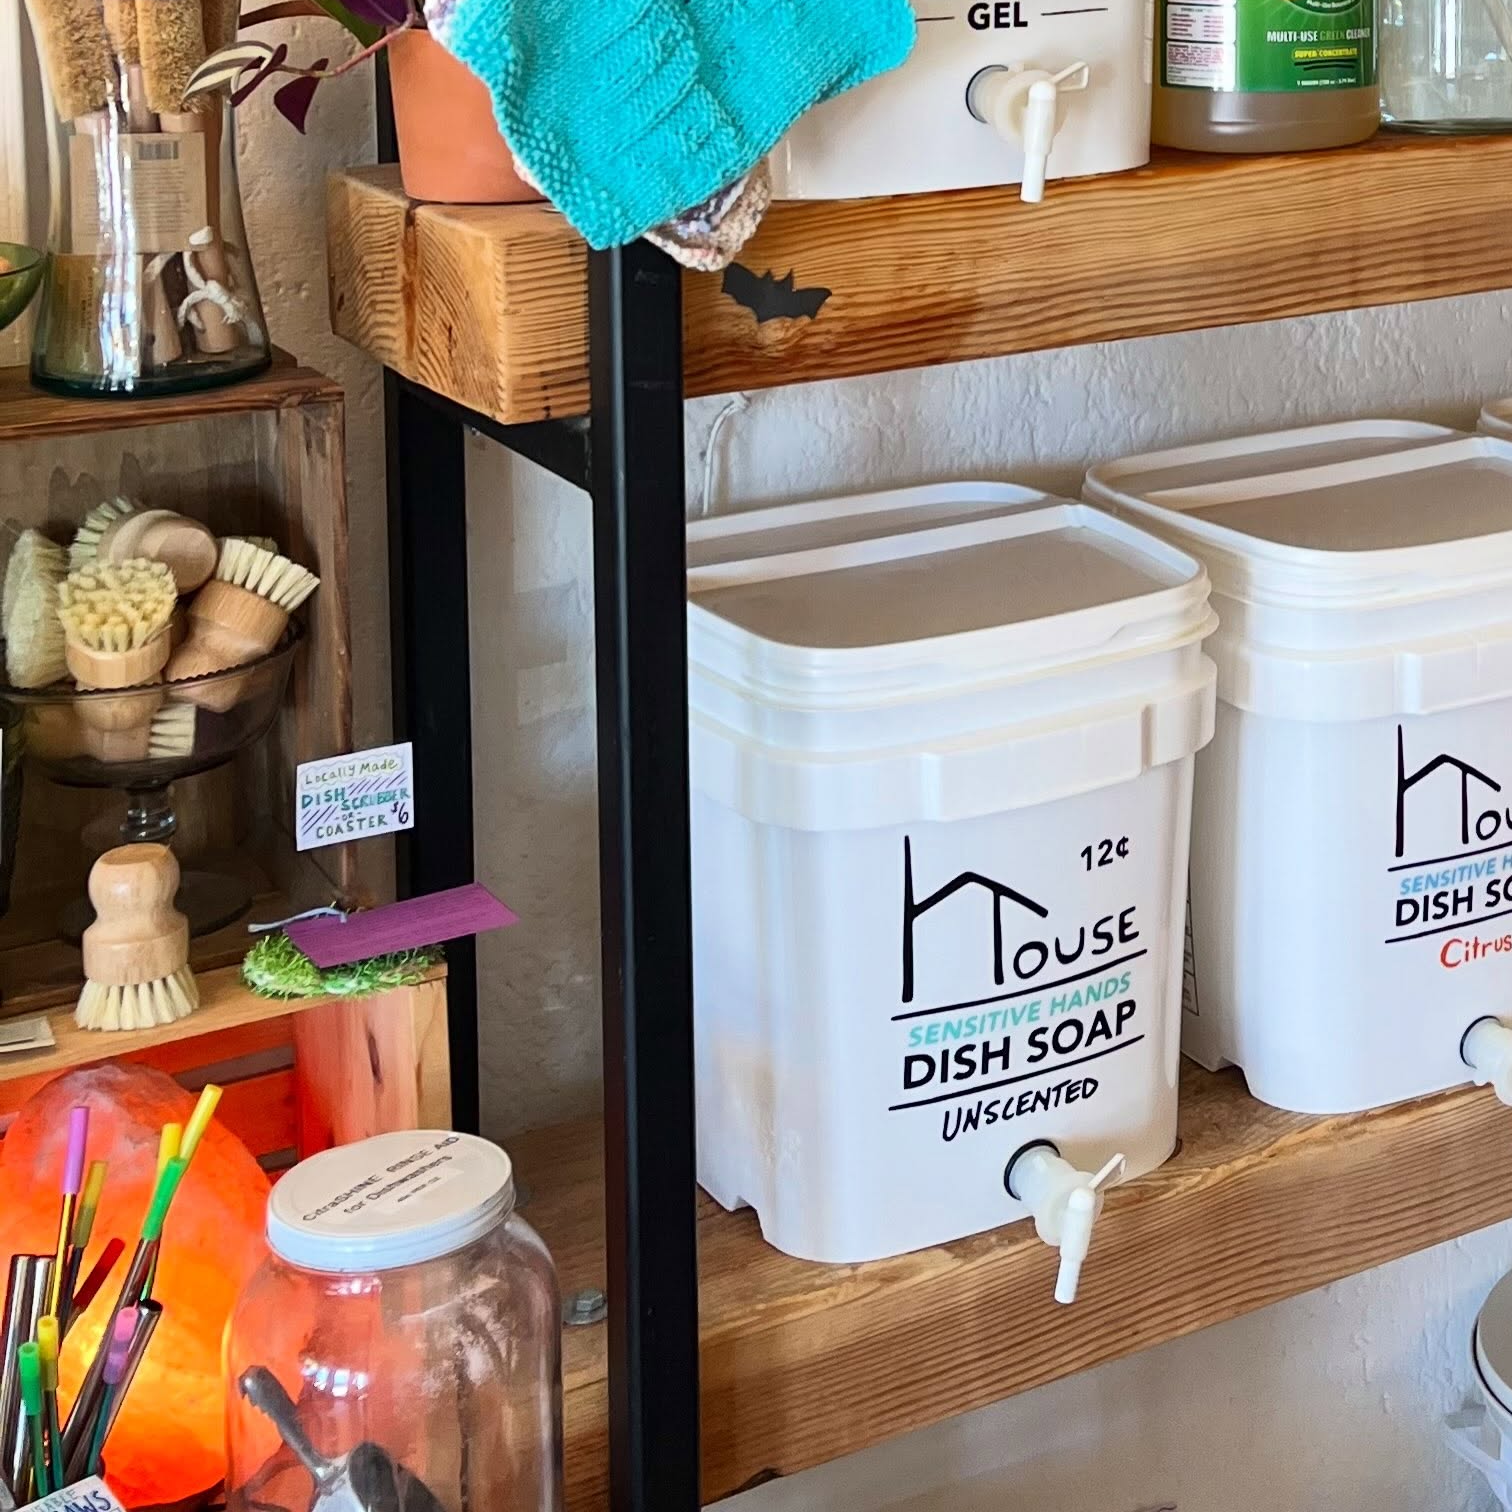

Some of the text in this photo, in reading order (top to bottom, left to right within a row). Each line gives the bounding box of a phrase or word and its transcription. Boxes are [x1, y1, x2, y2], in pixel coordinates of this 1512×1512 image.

[967, 2, 1029, 30] GEL
[1266, 30, 1318, 42] MULTI-USE
[1320, 30, 1345, 41] GREEN
[305, 758, 399, 785] Locally Made
[301, 787, 346, 809] DISH
[341, 788, 410, 811] SCRUBBER
[391, 801, 409, 825] $6
[316, 814, 388, 839] COASTER
[1080, 836, 1130, 871] 12¢
[1400, 857, 1497, 896] SENSITIVE
[1395, 885, 1474, 927] DISH
[1440, 934, 1512, 969] Citrus
[907, 971, 1132, 1048] SENSITIVE HANDS
[903, 999, 1136, 1090] DISH SOAP
[942, 1077, 1099, 1142] UNSCENTED
[386, 1149, 434, 1173] RINSE
[434, 1136, 460, 1150] AID
[343, 1155, 453, 1215] for Dishwashers
